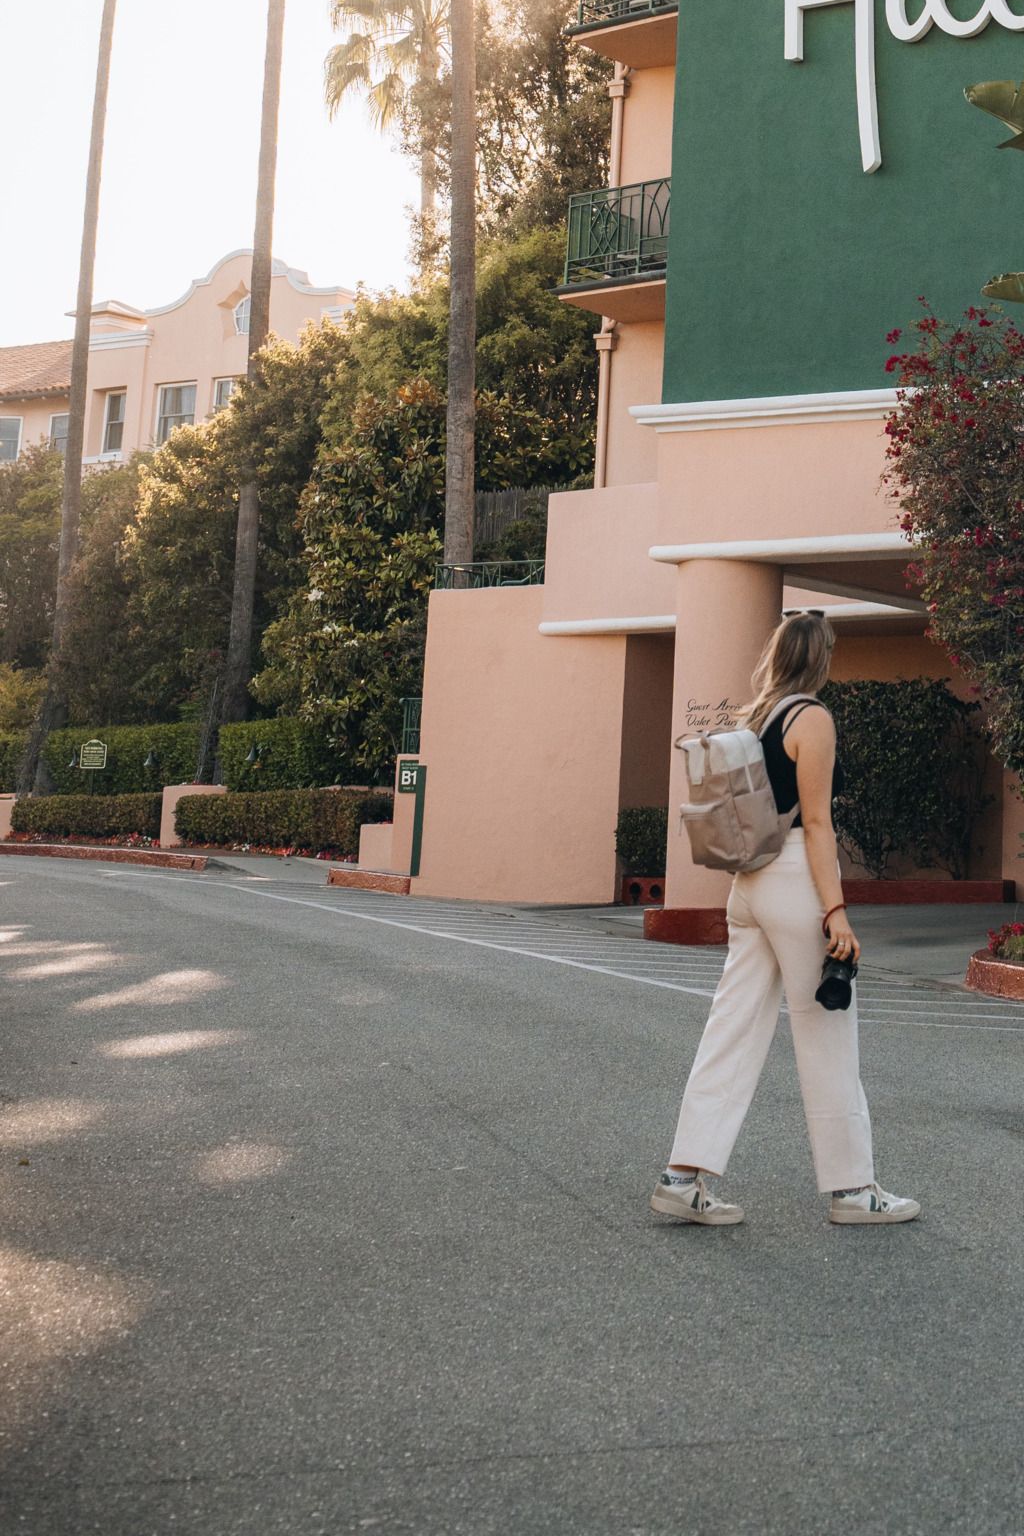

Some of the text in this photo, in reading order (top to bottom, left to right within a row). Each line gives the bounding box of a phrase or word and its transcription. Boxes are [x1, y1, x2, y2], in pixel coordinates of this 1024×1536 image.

[686, 698, 710, 712] Guest
[685, 713, 711, 727] Valet
[401, 770, 417, 785] B1
